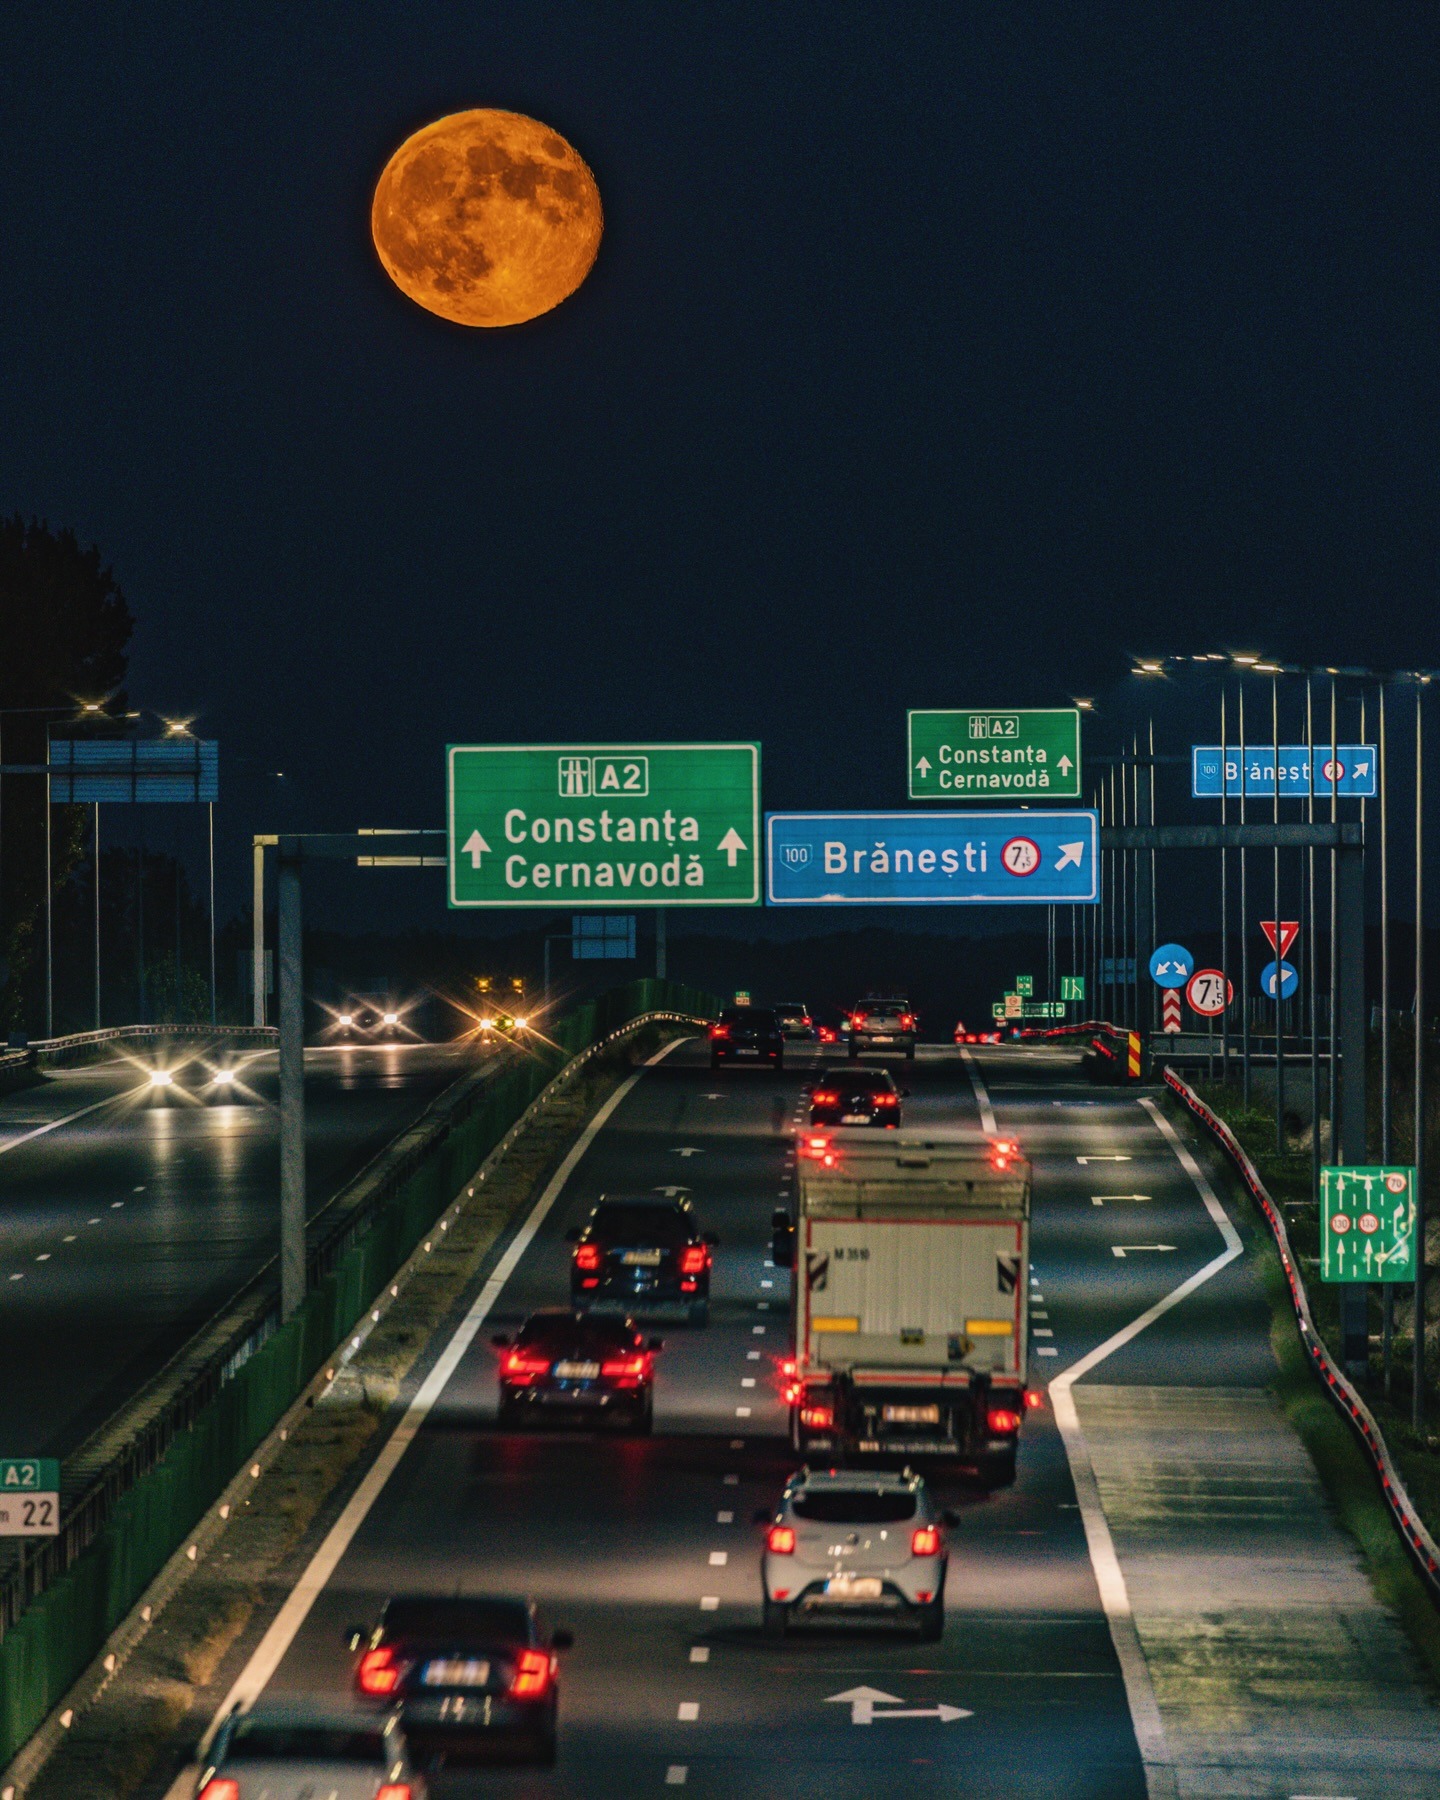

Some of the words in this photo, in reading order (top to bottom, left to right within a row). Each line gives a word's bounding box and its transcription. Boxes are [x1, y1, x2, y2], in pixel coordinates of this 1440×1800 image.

[992, 720, 1015, 735] A2
[939, 744, 1047, 766] Constanța
[600, 764, 641, 790] A2
[939, 769, 1050, 789] Cernavodă
[1225, 762, 1315, 783] Băneșt
[504, 808, 699, 847] Constanța
[786, 848, 808, 862] 100
[824, 841, 987, 878] Brănești
[505, 853, 704, 889] Cernavodă
[1390, 1178, 1402, 1188] 70
[1333, 1218, 1348, 1229] 130
[1361, 1217, 1376, 1229] 130
[5, 1464, 35, 1486] A2
[23, 1500, 53, 1527] 22
